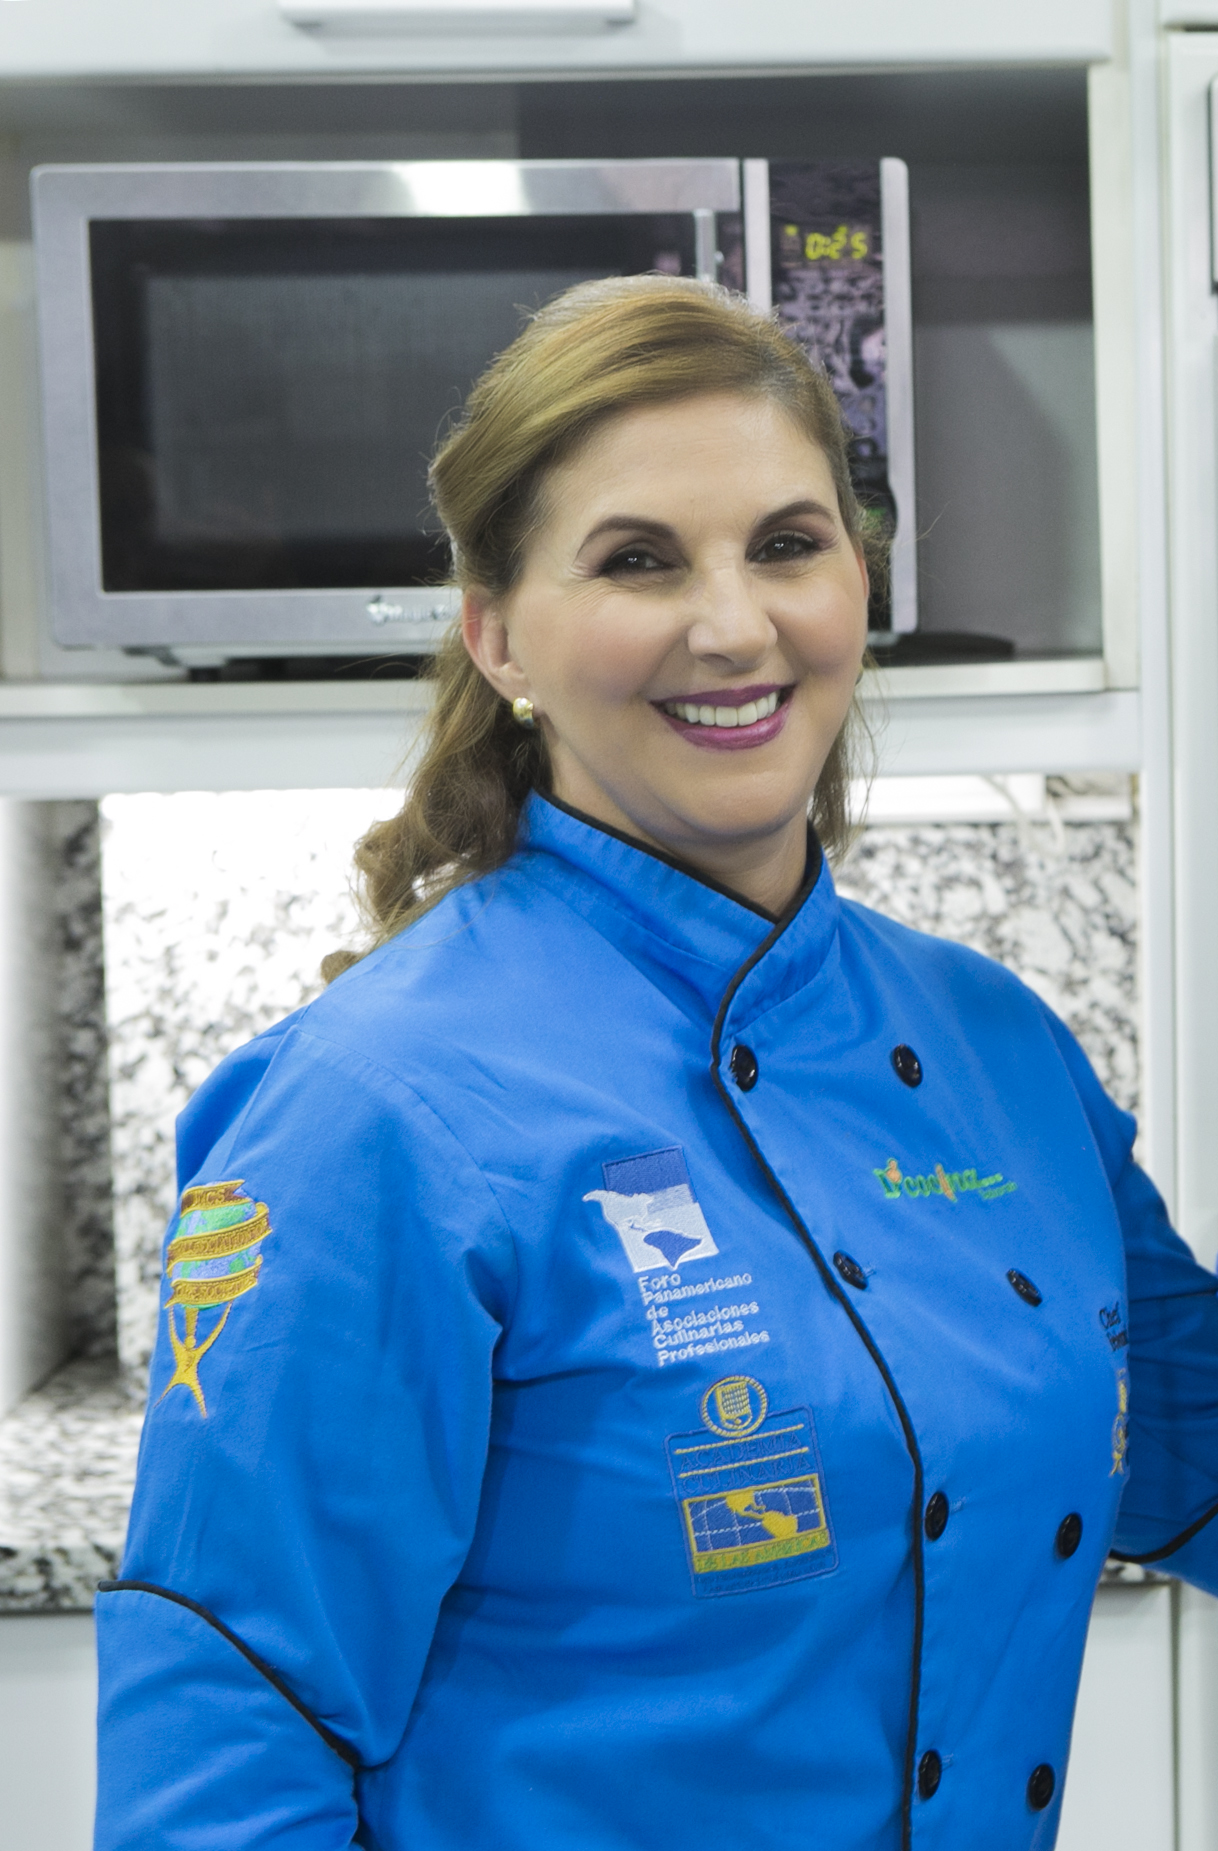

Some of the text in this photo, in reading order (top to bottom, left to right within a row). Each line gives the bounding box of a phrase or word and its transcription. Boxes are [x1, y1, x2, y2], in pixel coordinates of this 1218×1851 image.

[638, 1273, 681, 1293] Foro
[642, 1272, 752, 1306] Panamericano
[646, 1306, 669, 1321] de
[652, 1300, 760, 1336] Asociaciones
[653, 1319, 744, 1350] Culinarias
[657, 1329, 770, 1367] Profesionales
